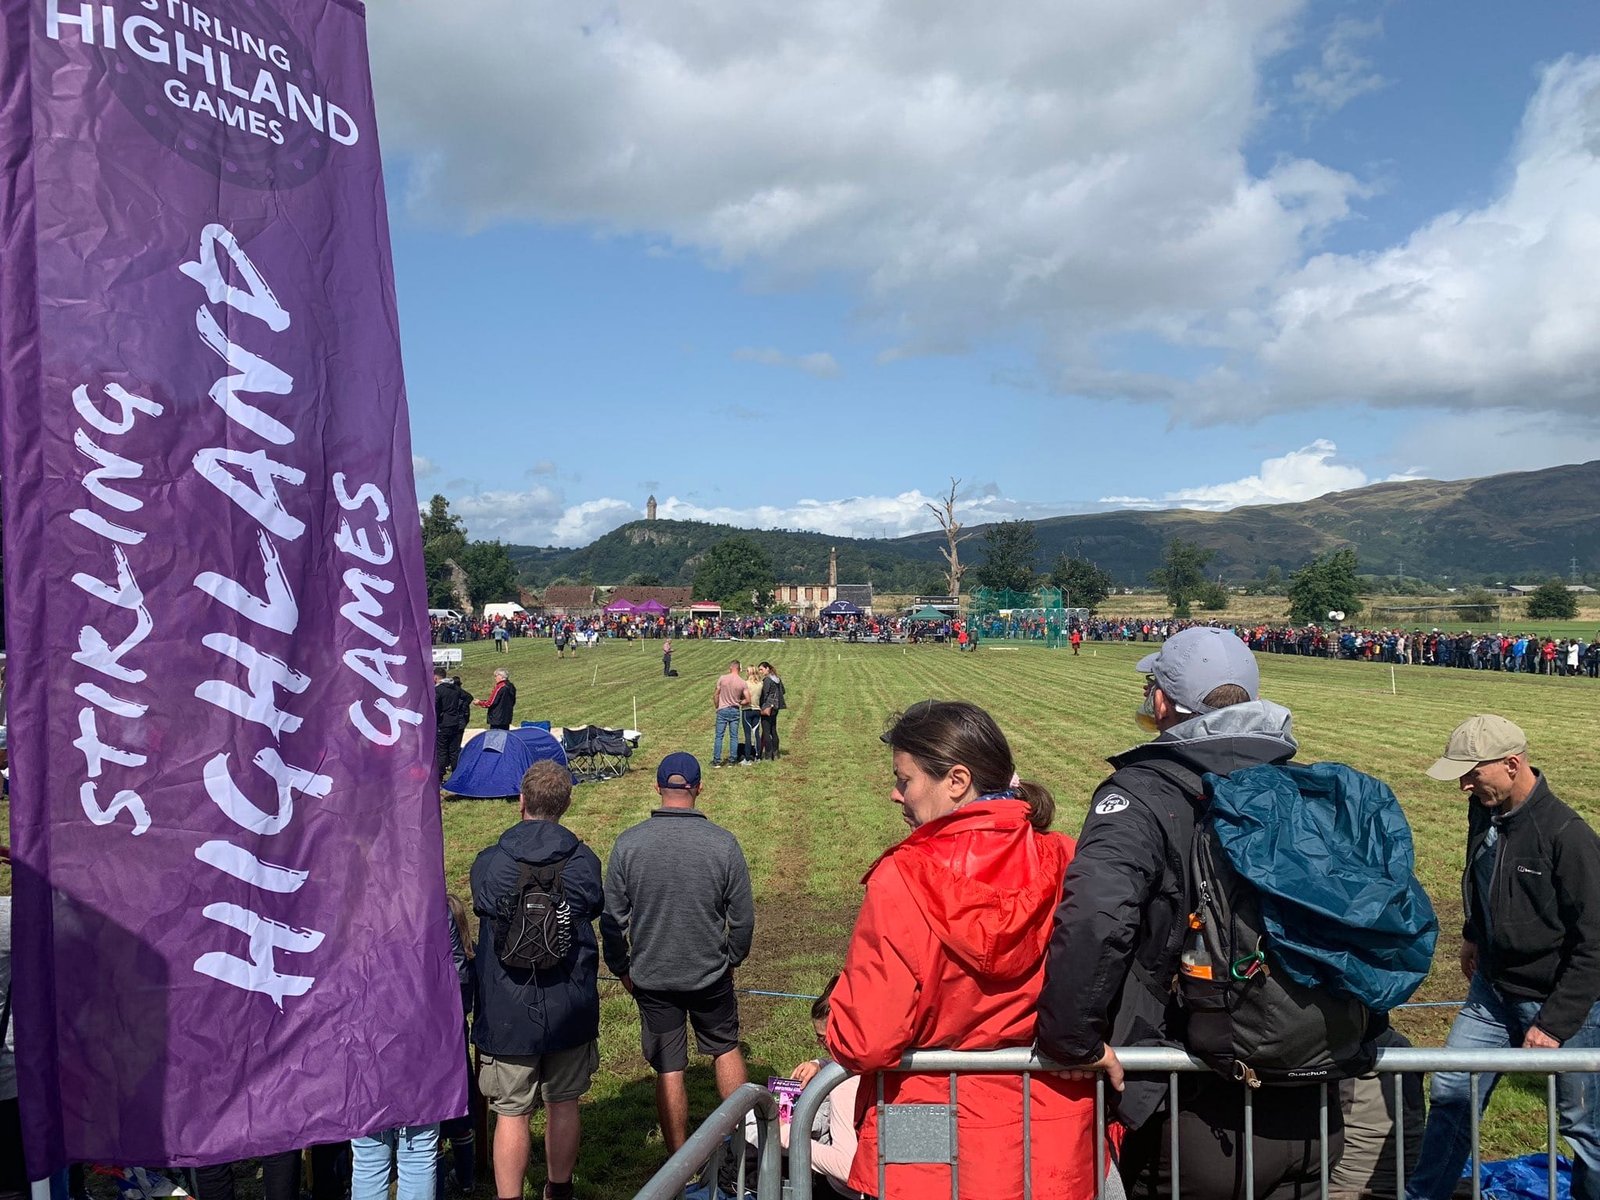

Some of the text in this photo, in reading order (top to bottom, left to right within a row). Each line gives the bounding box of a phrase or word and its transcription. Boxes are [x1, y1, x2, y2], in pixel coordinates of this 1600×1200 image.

[46, 0, 359, 146] HIGHLAND
[163, 79, 286, 146] GAMES
[69, 382, 164, 836] STIRLING
[178, 223, 334, 1013] HIGHLAND
[332, 471, 424, 746] GAMES
